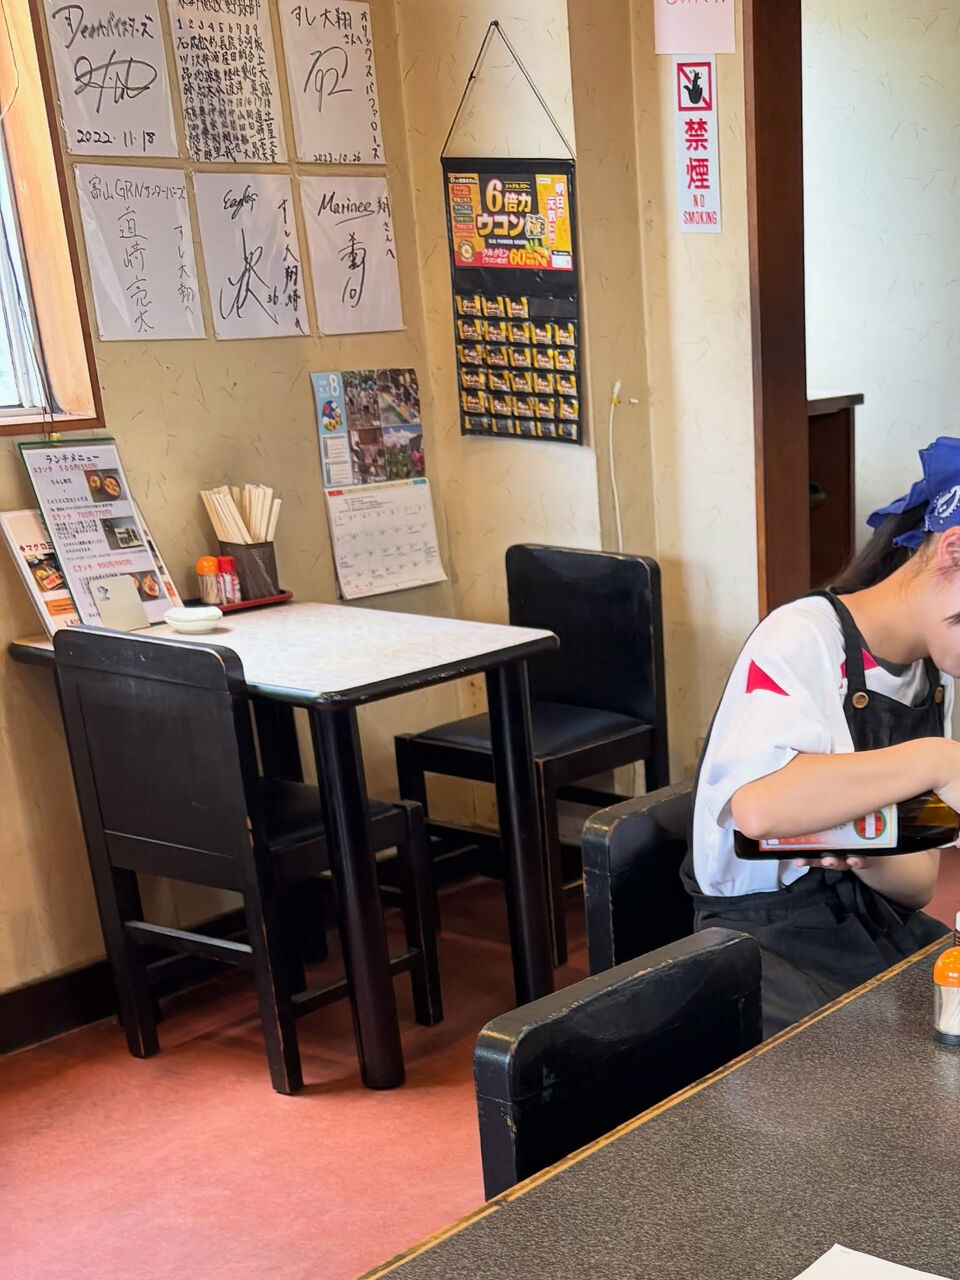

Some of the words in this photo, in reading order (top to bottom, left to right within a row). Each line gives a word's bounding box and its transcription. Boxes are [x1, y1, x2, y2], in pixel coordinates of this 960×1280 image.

[684, 118, 710, 190] 禁煙
[693, 194, 705, 208] NO
[477, 213, 525, 237] ウコン
[683, 210, 717, 225] SMOKING
[329, 375, 339, 397] 8
[46, 453, 100, 464] ランチメニュー
